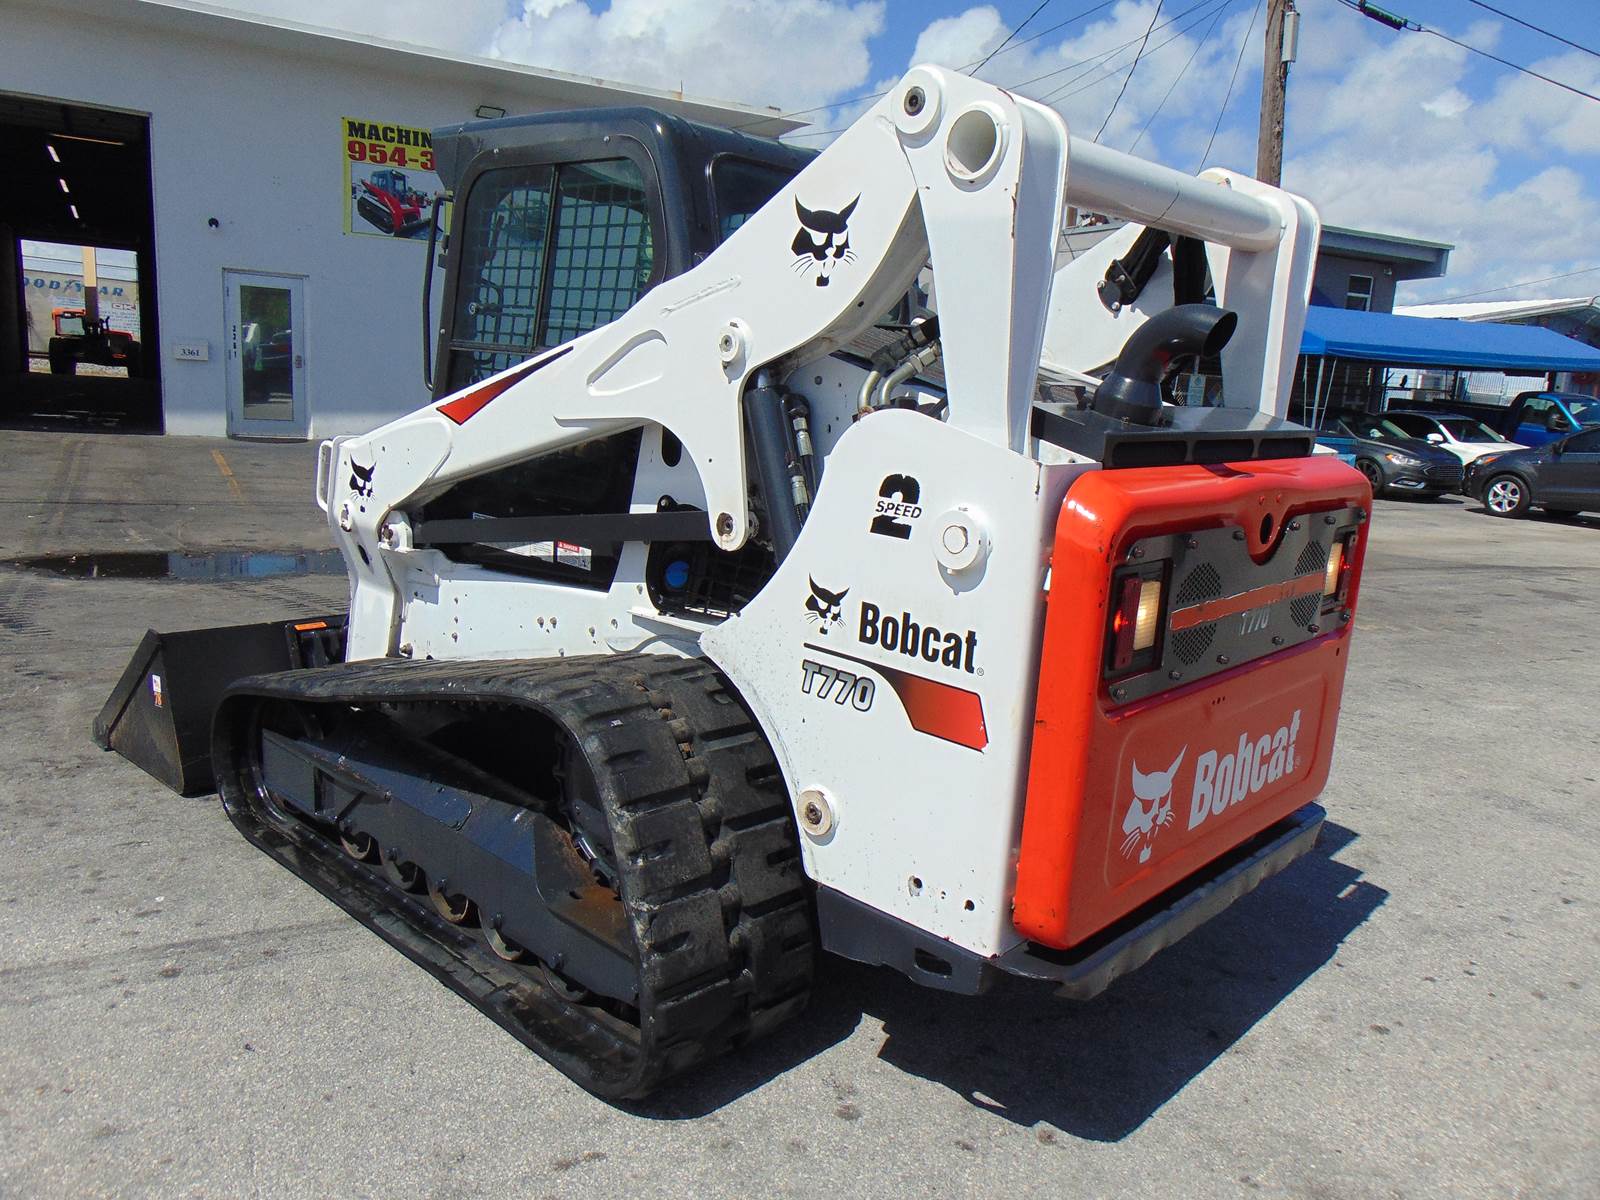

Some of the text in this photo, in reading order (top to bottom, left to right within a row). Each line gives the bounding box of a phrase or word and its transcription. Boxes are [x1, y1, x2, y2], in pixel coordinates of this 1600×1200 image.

[181, 348, 200, 356] 3361
[870, 473, 922, 540] 2 SPEED
[858, 601, 977, 674] Bobcat
[802, 659, 876, 712] T770
[1188, 709, 1301, 831] Bobcat
